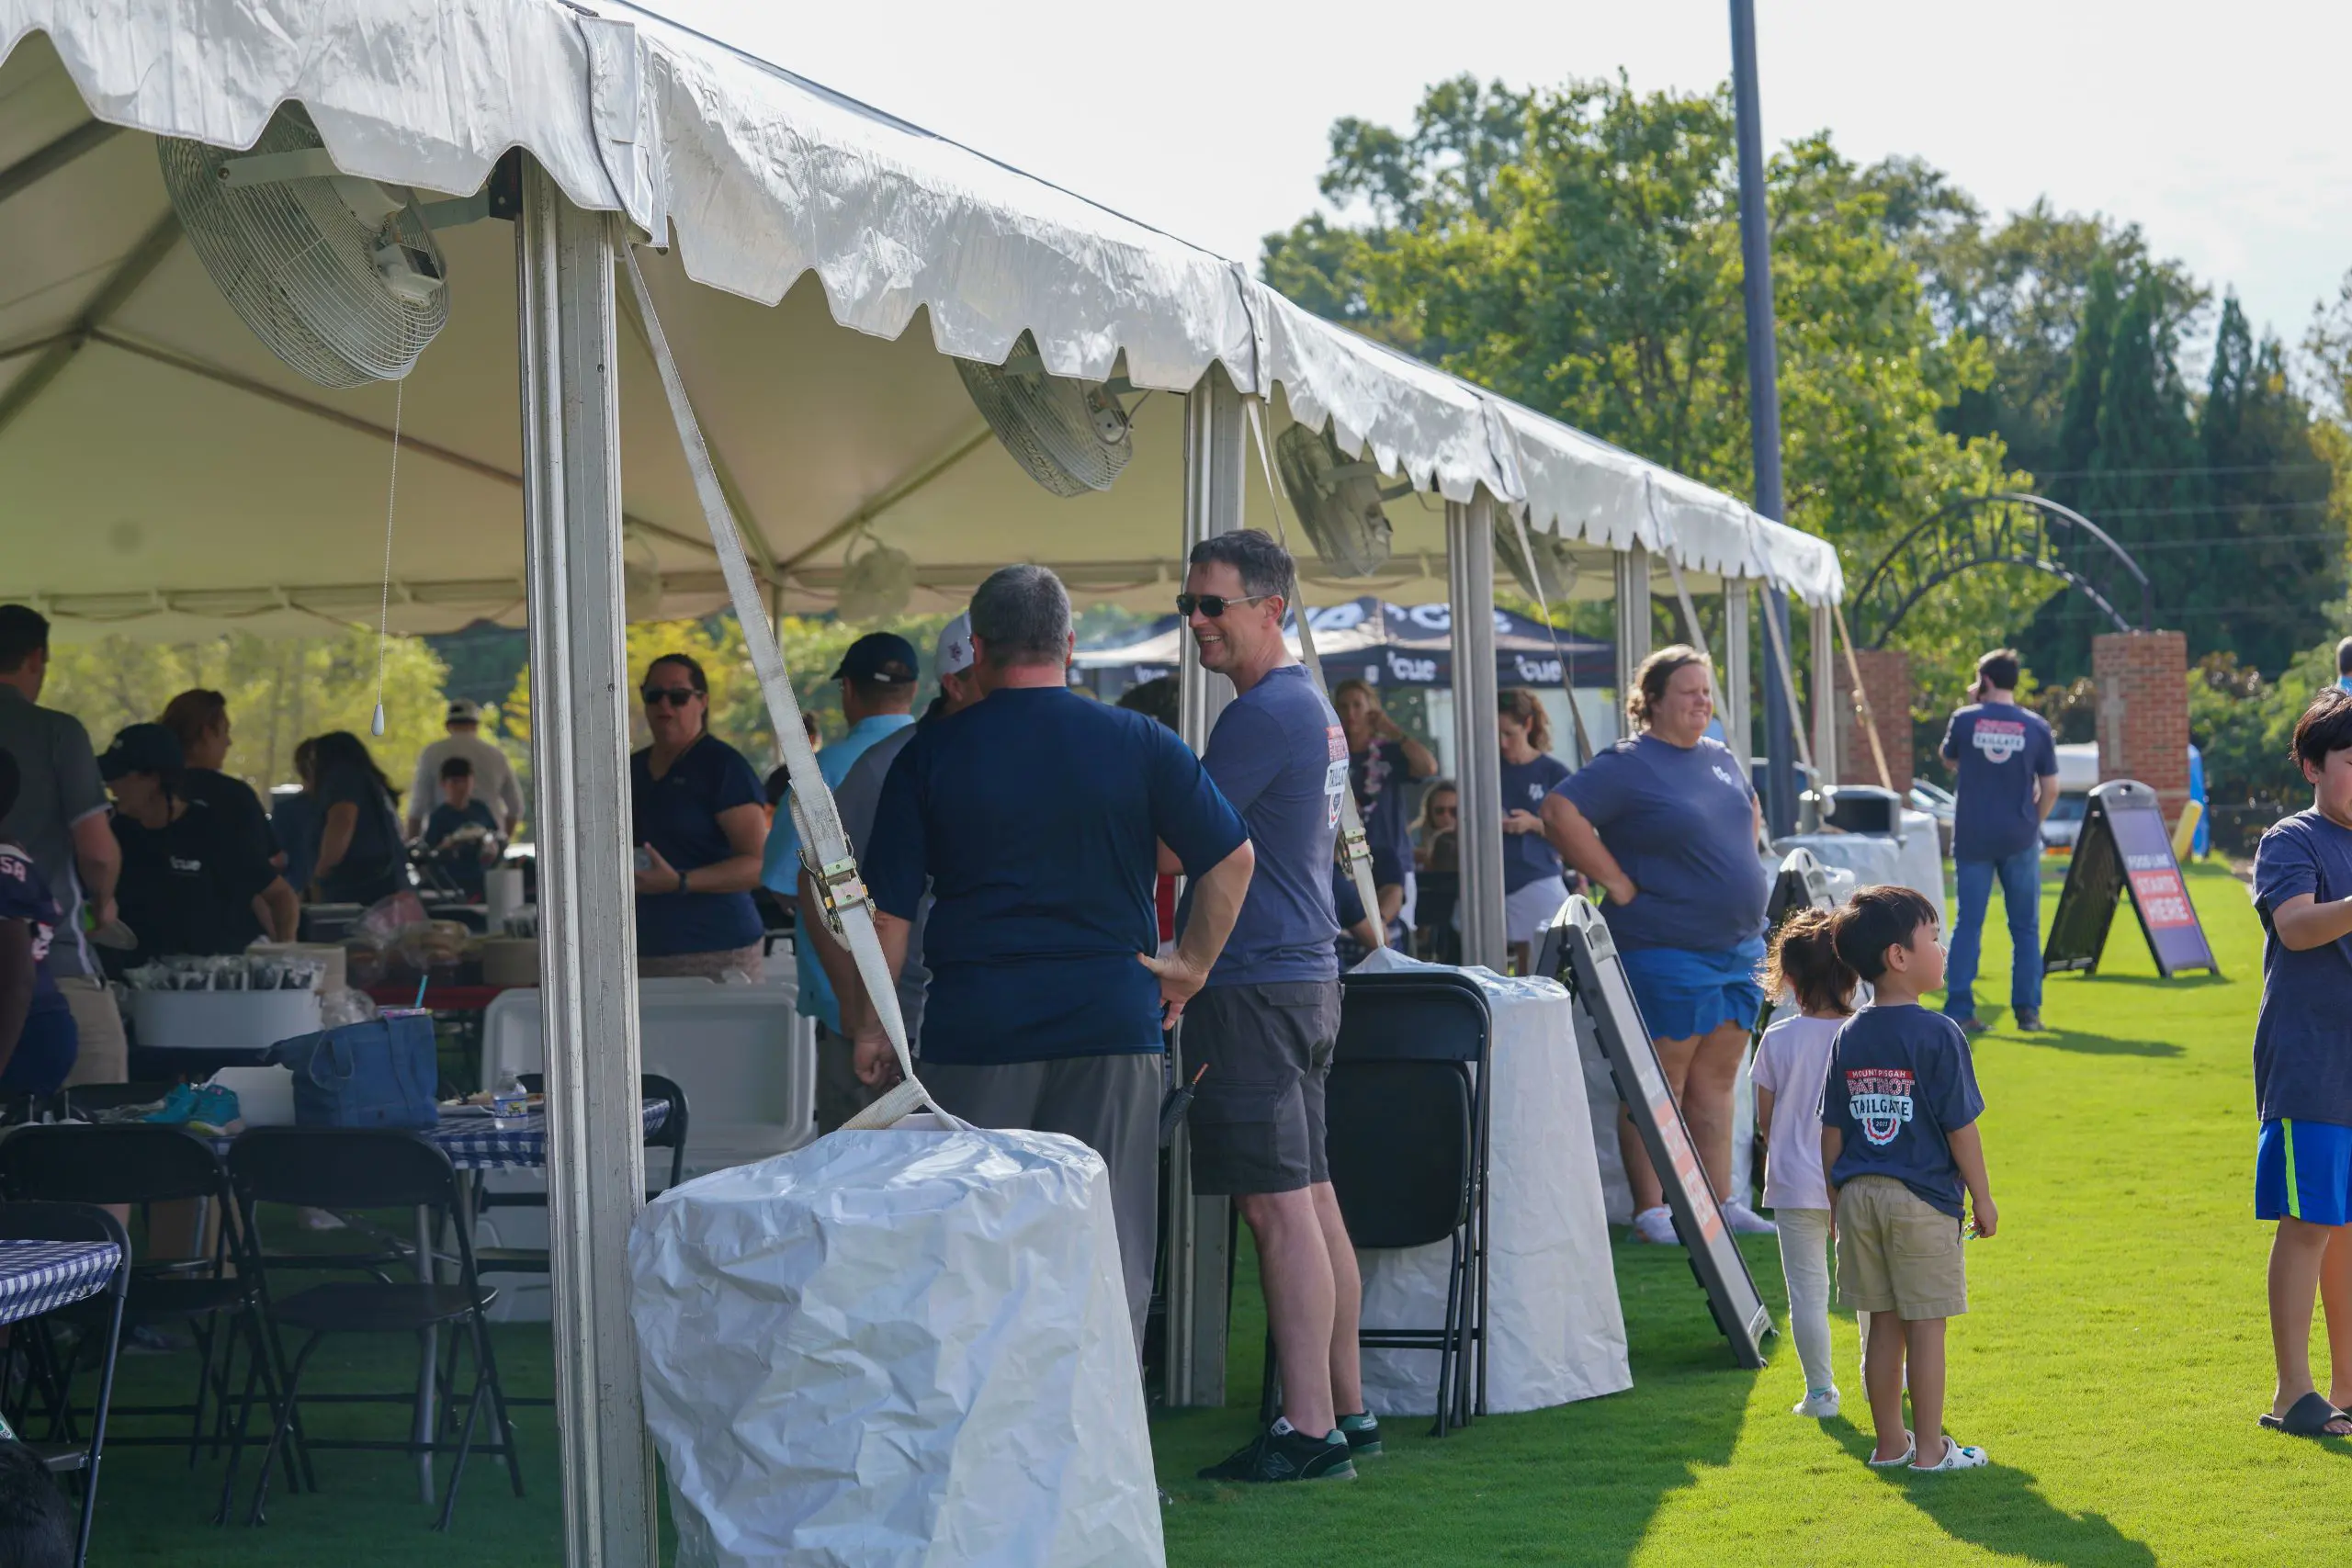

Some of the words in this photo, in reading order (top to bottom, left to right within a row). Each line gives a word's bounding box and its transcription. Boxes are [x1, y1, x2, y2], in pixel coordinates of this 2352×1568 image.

[2136, 875, 2178, 895] STARTS
[2146, 897, 2188, 922] HERE
[1852, 1068, 1877, 1078] MOUNT
[1878, 1069, 1905, 1078] PISGAH
[1847, 1077, 1915, 1097] PATRIOT
[1850, 1099, 1910, 1117] TAILGATE
